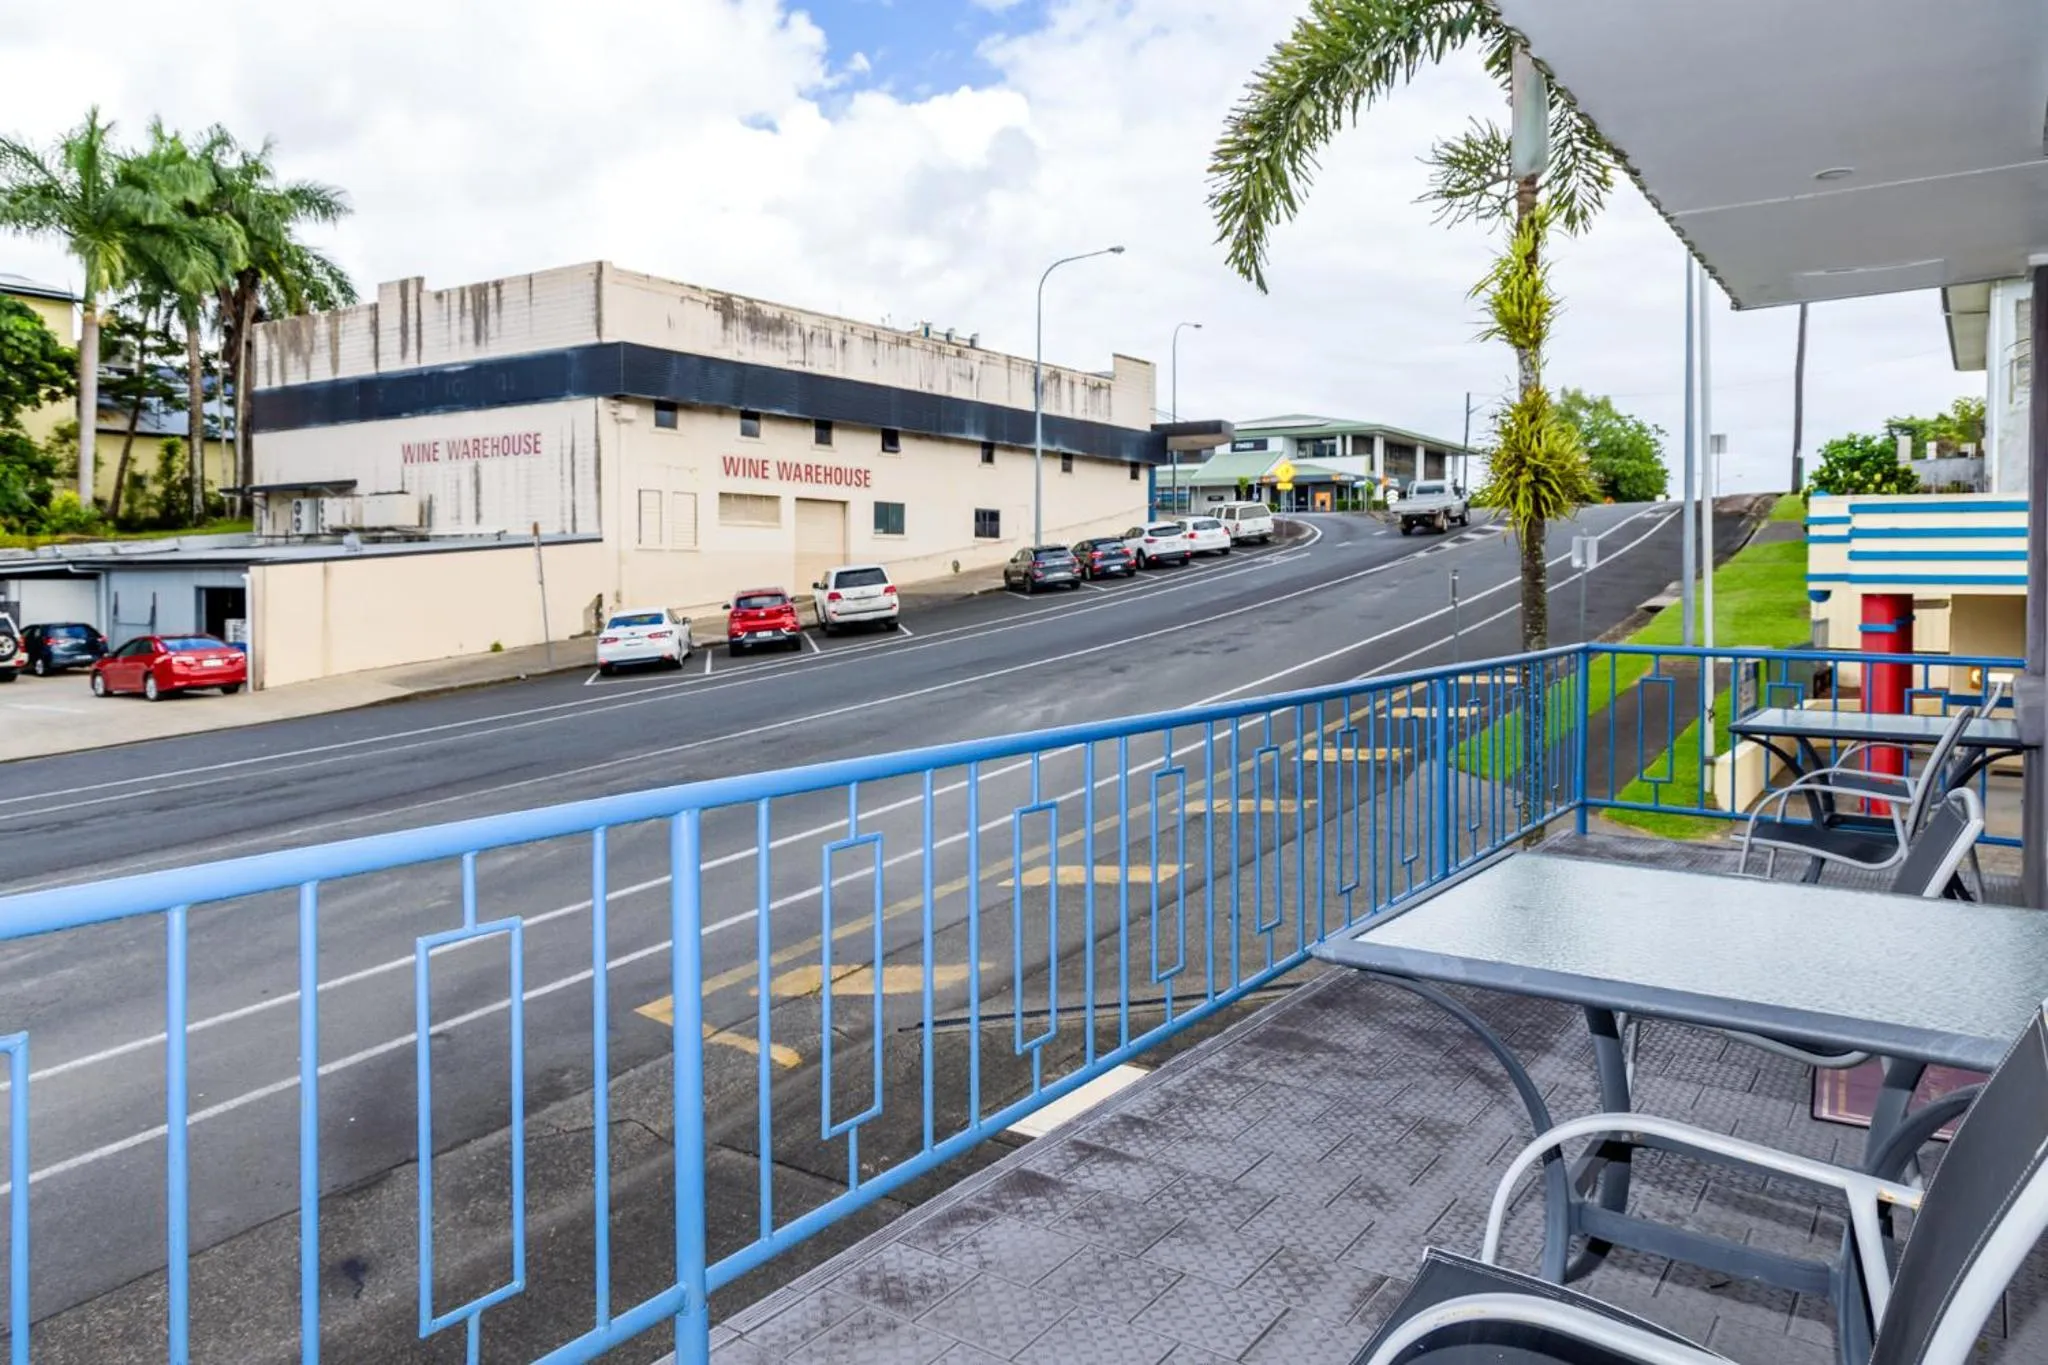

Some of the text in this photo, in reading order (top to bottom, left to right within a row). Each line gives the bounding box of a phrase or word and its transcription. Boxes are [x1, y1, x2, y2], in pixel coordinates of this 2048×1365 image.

[402, 432, 542, 464] WINE WAREHOUSE
[722, 455, 872, 488] WINE WAREHOUSE
